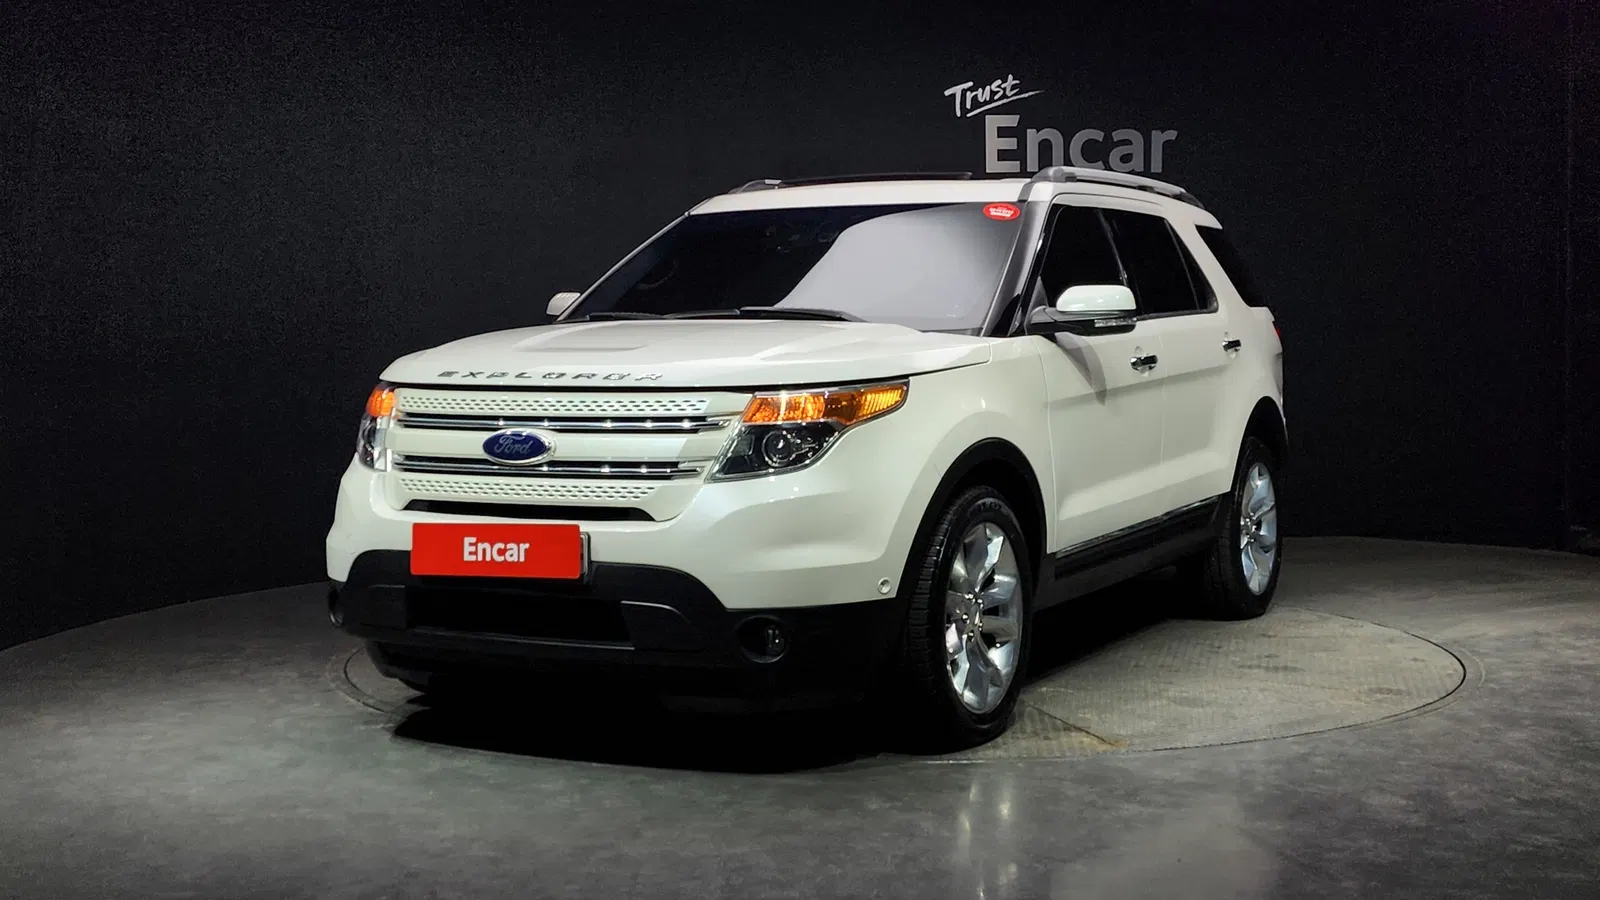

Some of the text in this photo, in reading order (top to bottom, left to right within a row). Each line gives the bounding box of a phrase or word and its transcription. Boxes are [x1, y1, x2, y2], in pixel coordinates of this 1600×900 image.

[944, 74, 1020, 117] Trust
[985, 115, 1178, 173] Encar
[494, 434, 533, 455] Ford
[463, 537, 530, 562] Encar
